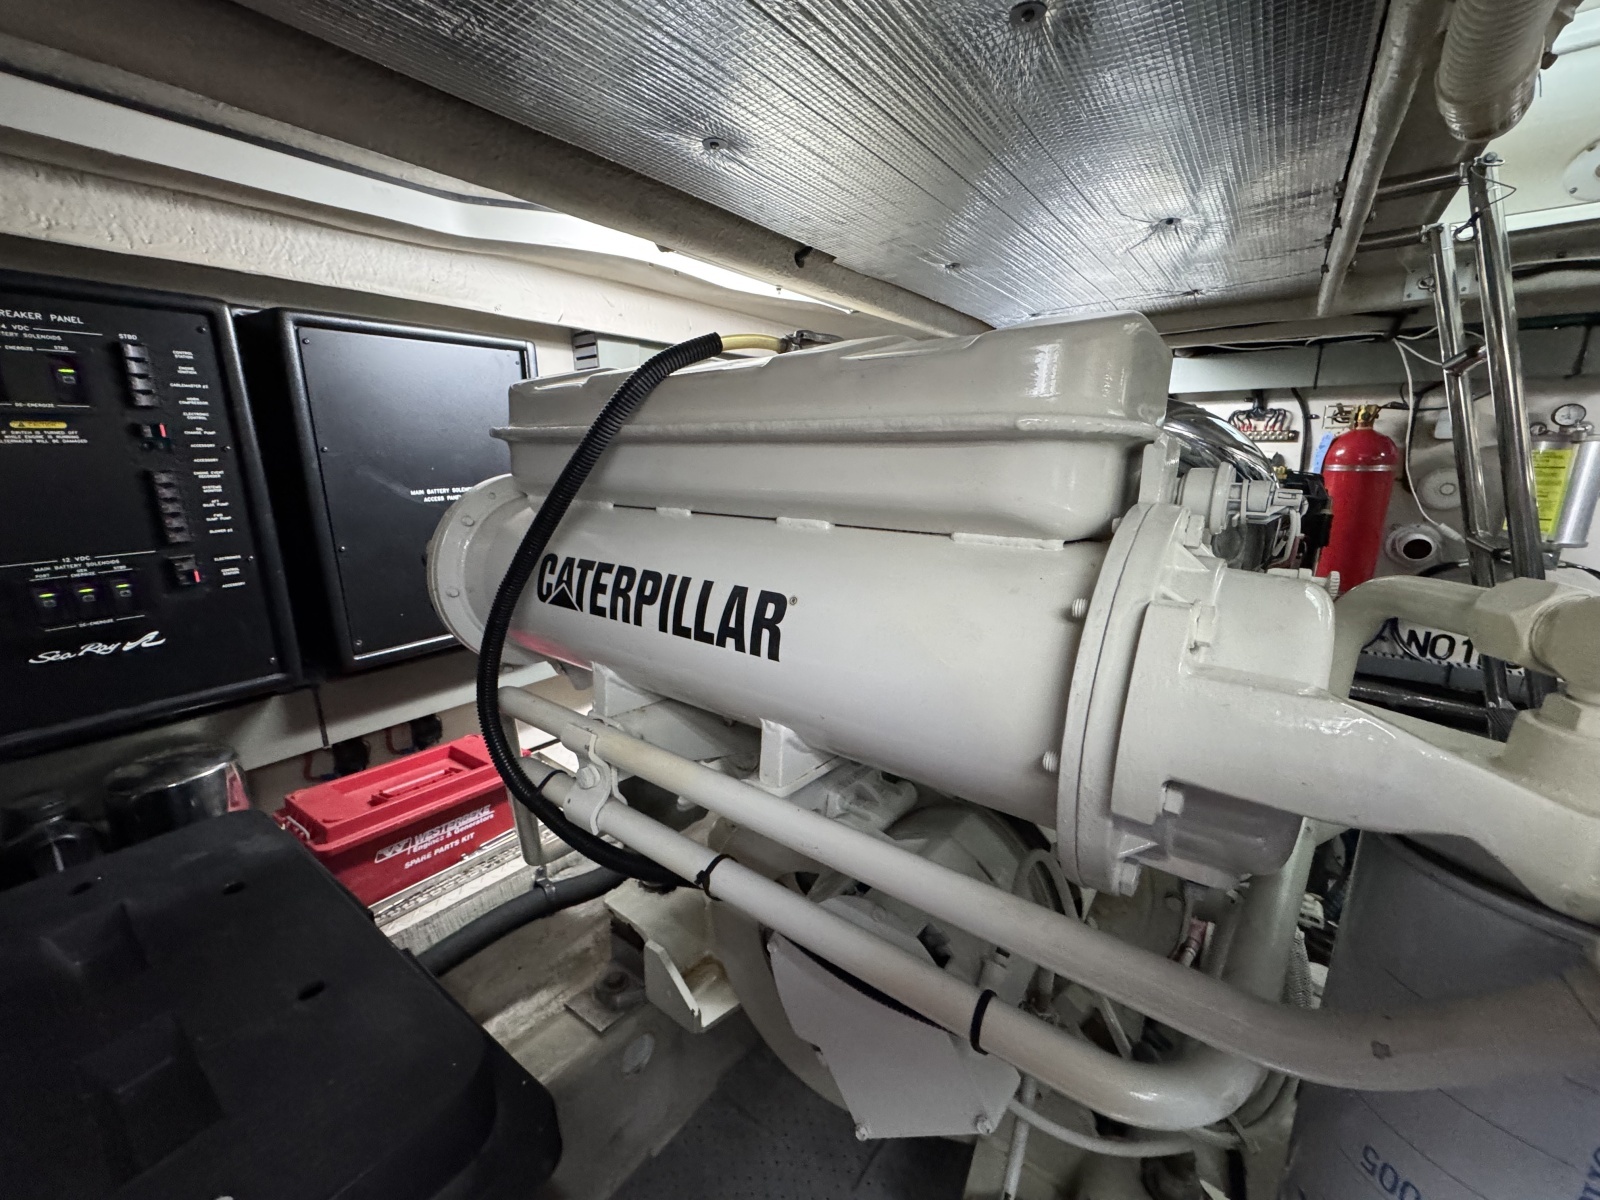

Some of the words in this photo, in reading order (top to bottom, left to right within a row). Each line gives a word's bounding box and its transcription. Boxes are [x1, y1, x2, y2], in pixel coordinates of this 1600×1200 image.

[50, 313, 84, 325] PANEL
[22, 332, 62, 341] SOLENOIDS
[117, 333, 138, 341] STBD
[426, 487, 450, 495] BATTERY
[85, 559, 120, 567] SOLENOIDS
[536, 552, 789, 662] CATERPILLAR
[28, 650, 77, 664] Sea
[77, 642, 122, 656] Ray
[412, 804, 492, 843] WESTERBEKE
[412, 835, 445, 853] Engines
[453, 813, 495, 835] Generators
[404, 851, 432, 869] SPARE
[433, 840, 460, 856] PARTS
[461, 831, 475, 843] KIT
